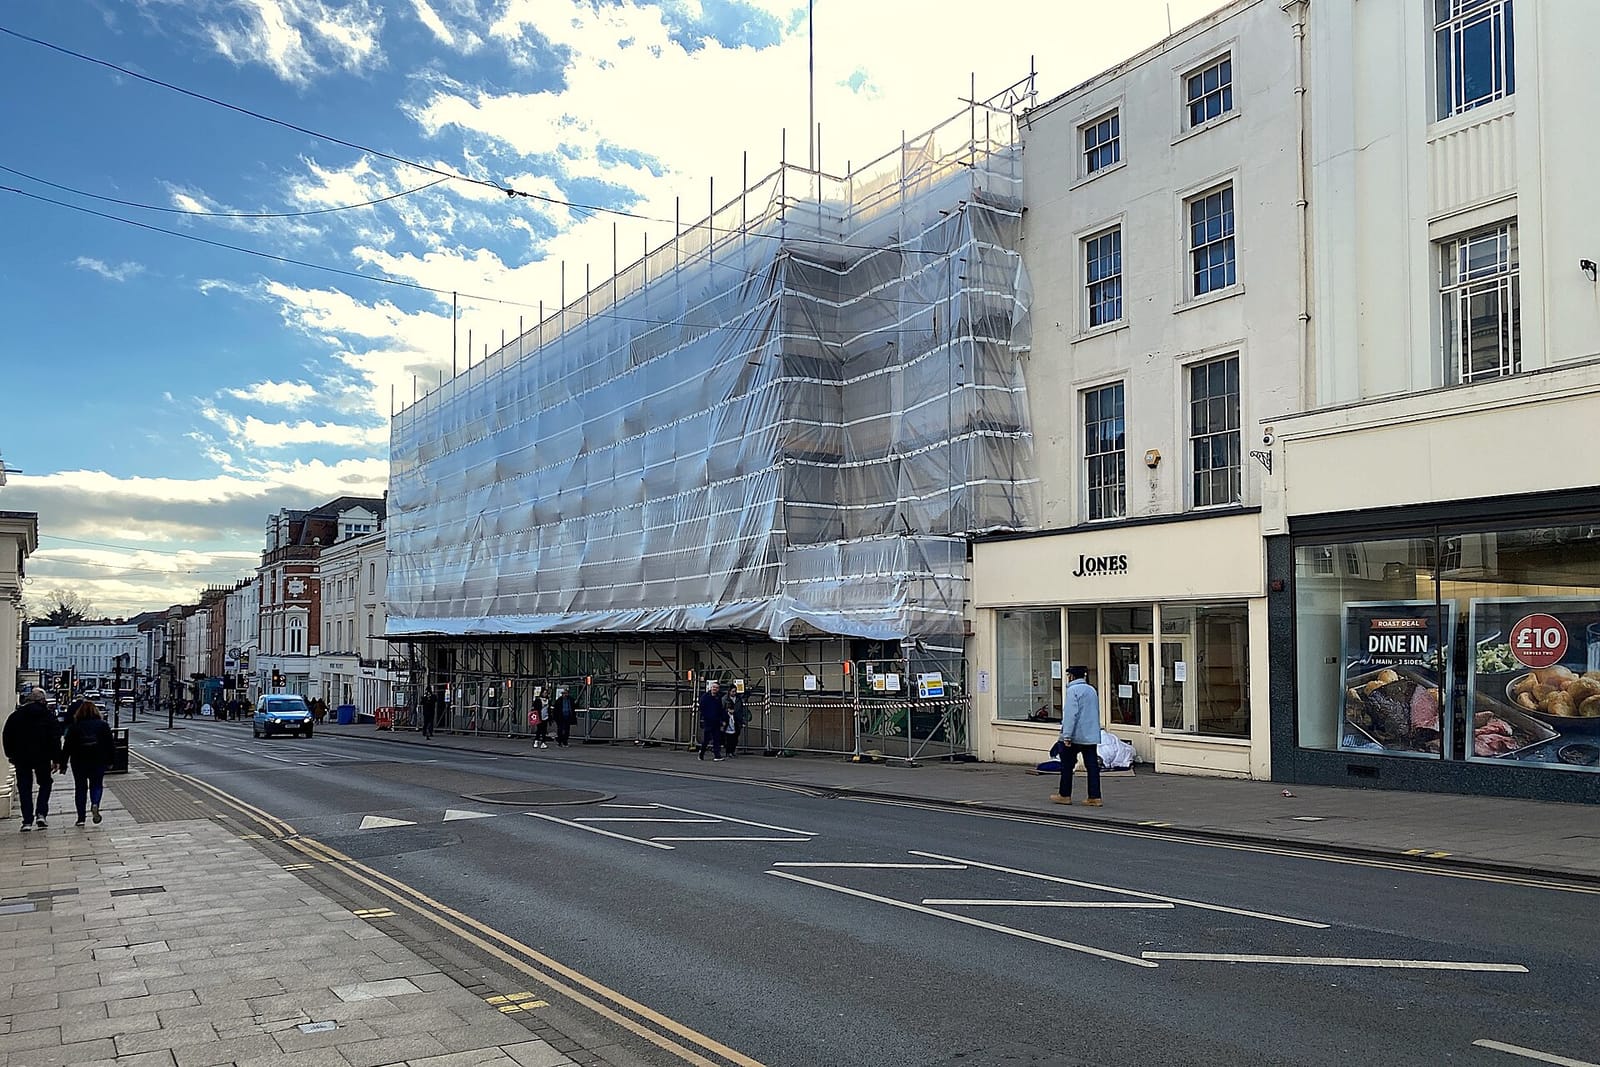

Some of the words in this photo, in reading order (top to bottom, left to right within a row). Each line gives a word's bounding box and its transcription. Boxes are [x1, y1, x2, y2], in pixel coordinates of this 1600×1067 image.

[1072, 554, 1128, 577] JONES
[1368, 635, 1407, 653] DINE
[1410, 635, 1428, 653] IN
[1516, 627, 1561, 649] £10
